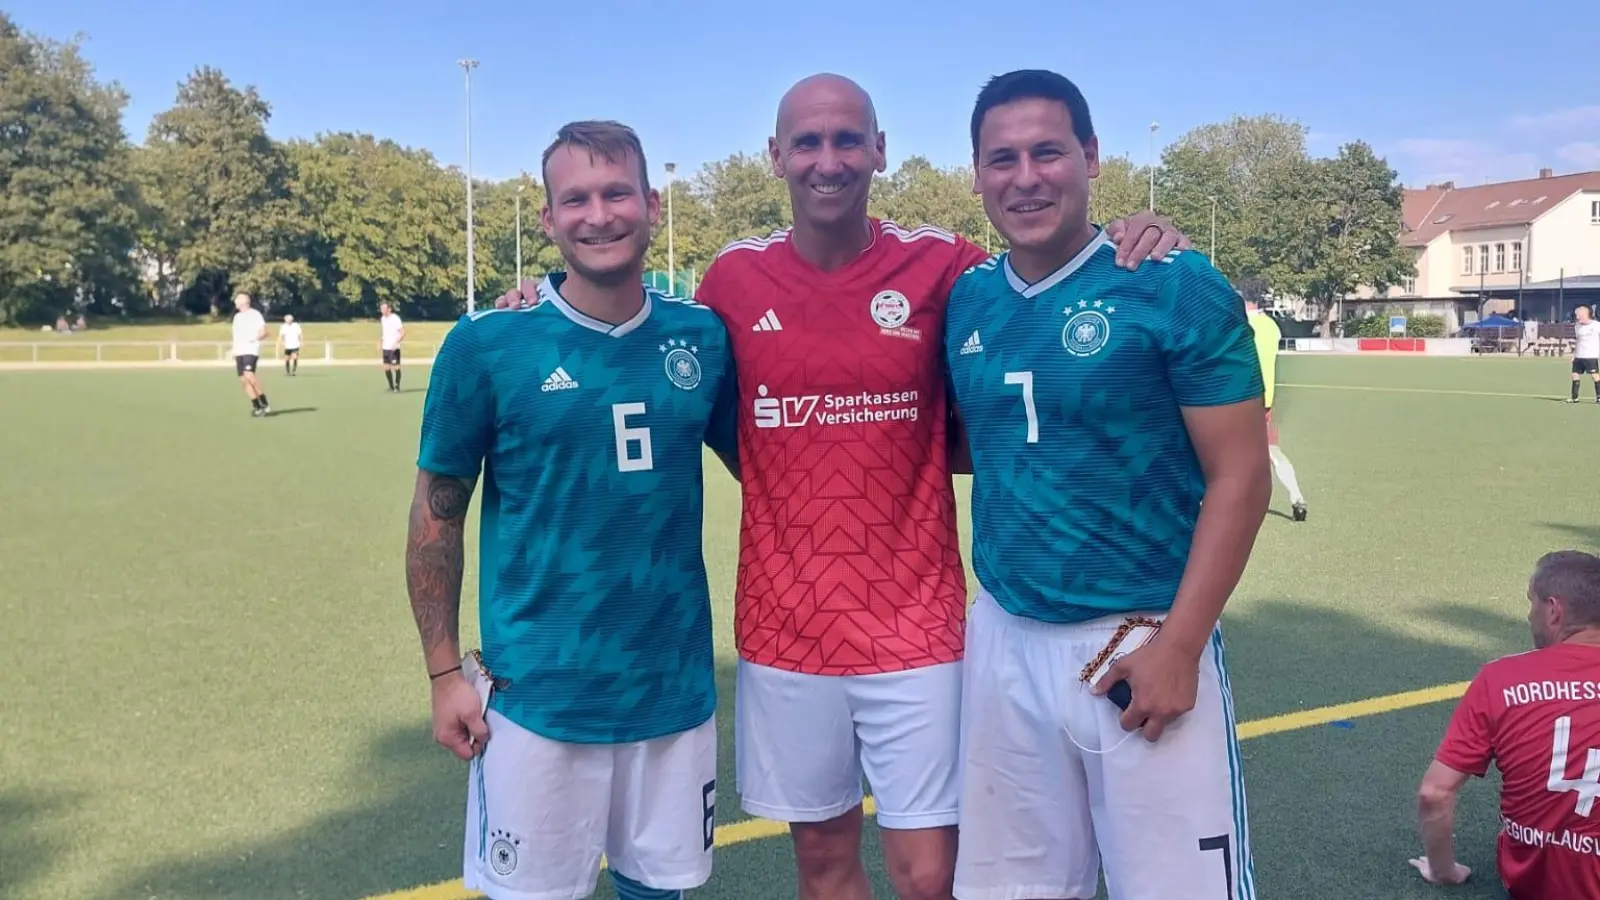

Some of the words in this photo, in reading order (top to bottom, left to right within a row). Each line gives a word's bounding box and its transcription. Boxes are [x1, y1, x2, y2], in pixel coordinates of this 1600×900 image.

[960, 345, 984, 355] adidas
[541, 380, 579, 392] adidas
[824, 390, 918, 410] Sparkassen
[1004, 371, 1039, 443] 7
[815, 407, 918, 425] Versicherung
[612, 402, 653, 472] 6
[1547, 715, 1600, 818] 4
